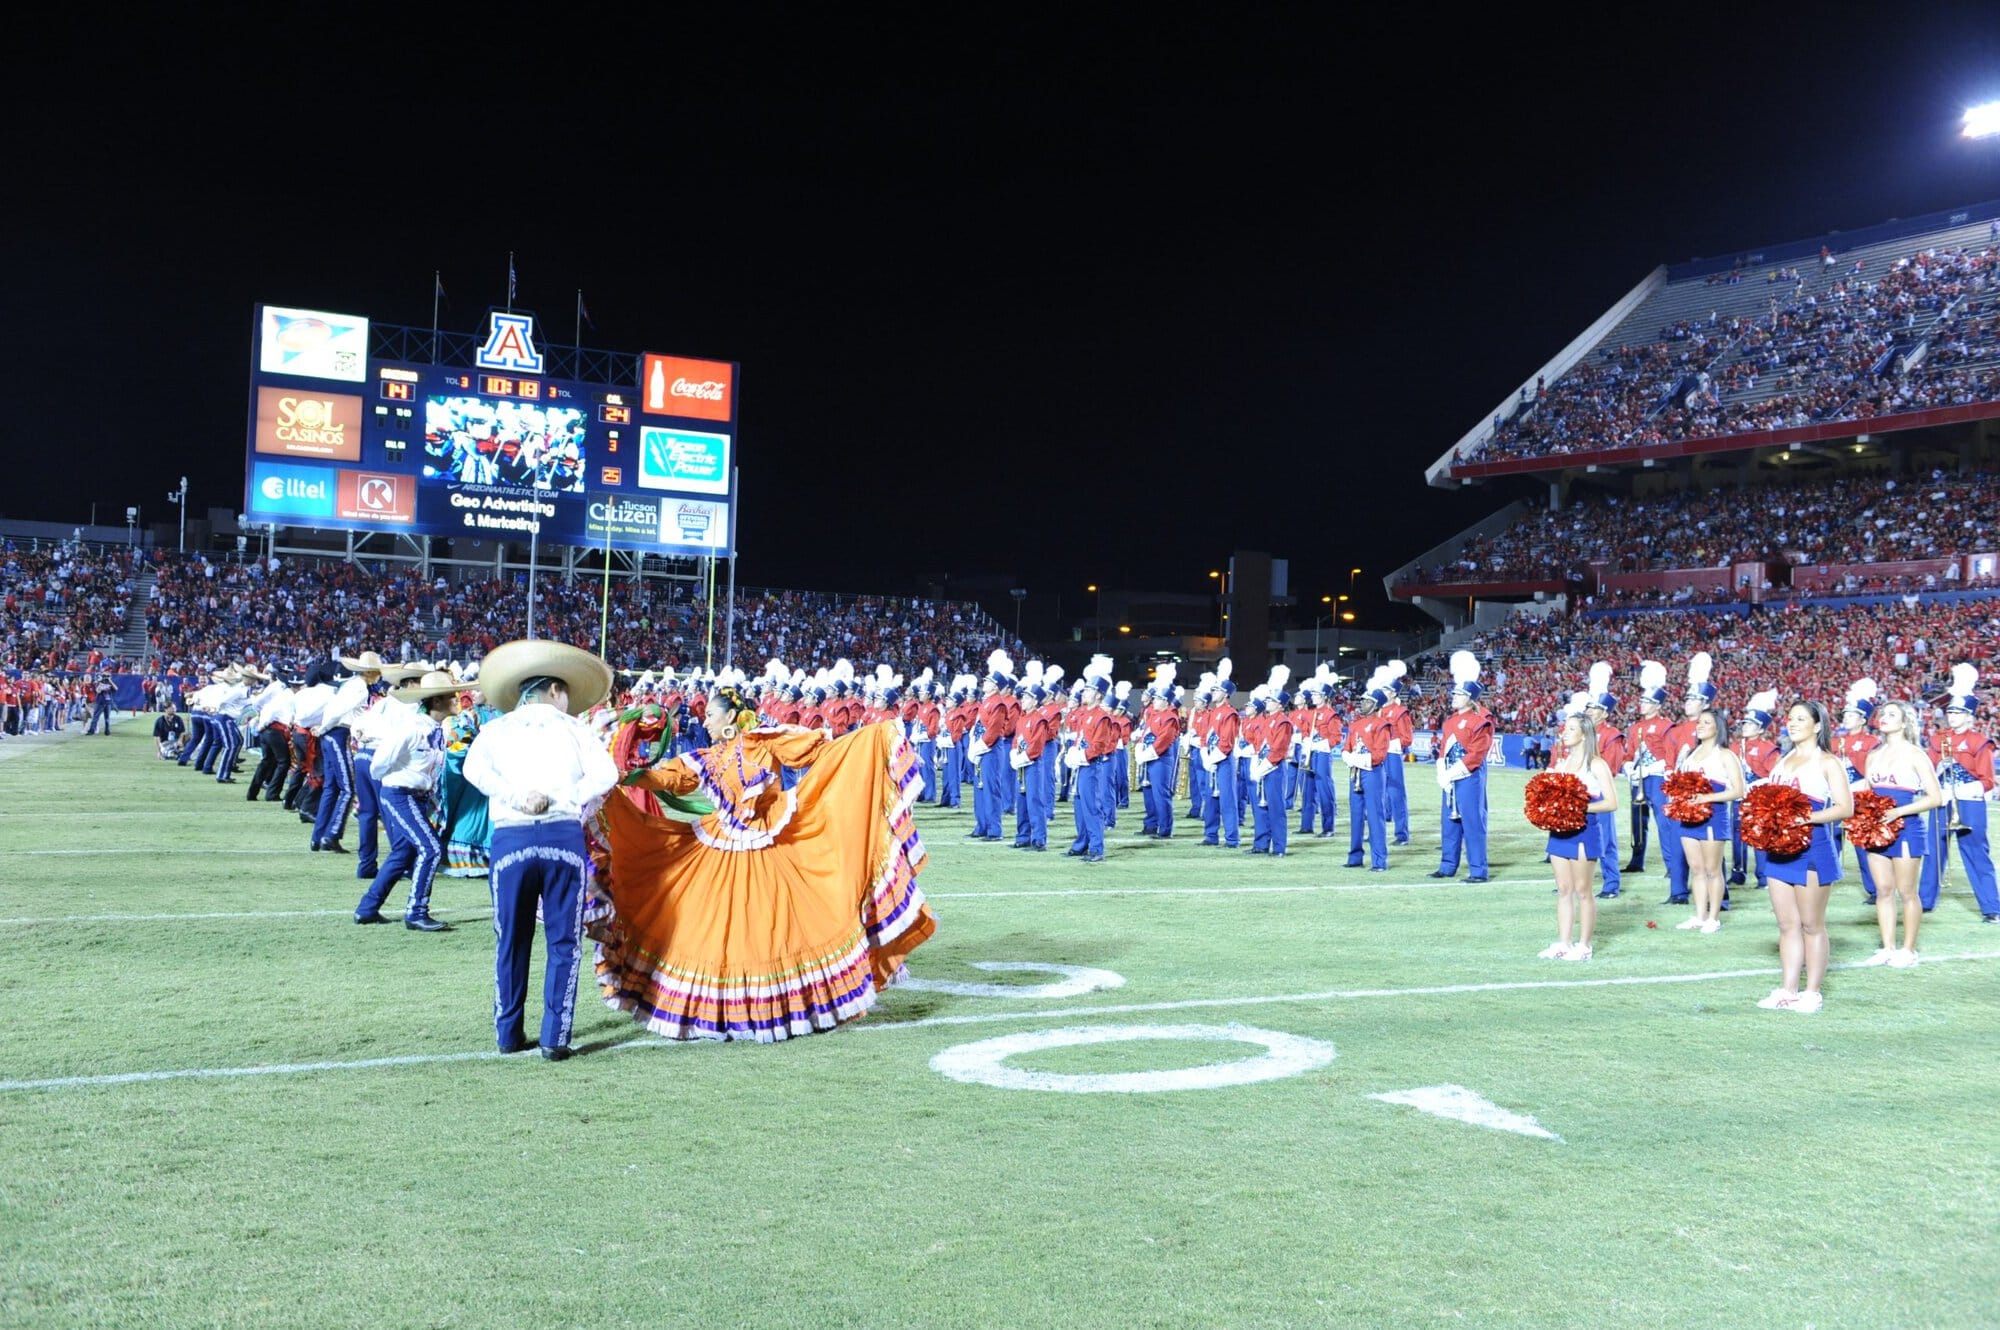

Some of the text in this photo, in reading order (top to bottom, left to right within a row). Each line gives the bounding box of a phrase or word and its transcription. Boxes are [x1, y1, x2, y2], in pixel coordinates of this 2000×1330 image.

[476, 312, 543, 373] A
[388, 383, 408, 399] 14
[445, 377, 469, 388] TOL 3
[487, 378, 538, 397] 10:18
[671, 378, 726, 400] Coca-Cola
[549, 387, 572, 398] 3 TOL
[277, 397, 344, 432] SOL
[606, 407, 629, 422] 24
[276, 426, 344, 445] CASINOS
[609, 440, 617, 452] 3
[603, 469, 620, 483] 25
[451, 493, 555, 516] Geo Advertising
[589, 503, 658, 524] Citizen
[623, 501, 656, 512] Tucson
[464, 513, 540, 534] & Marketing
